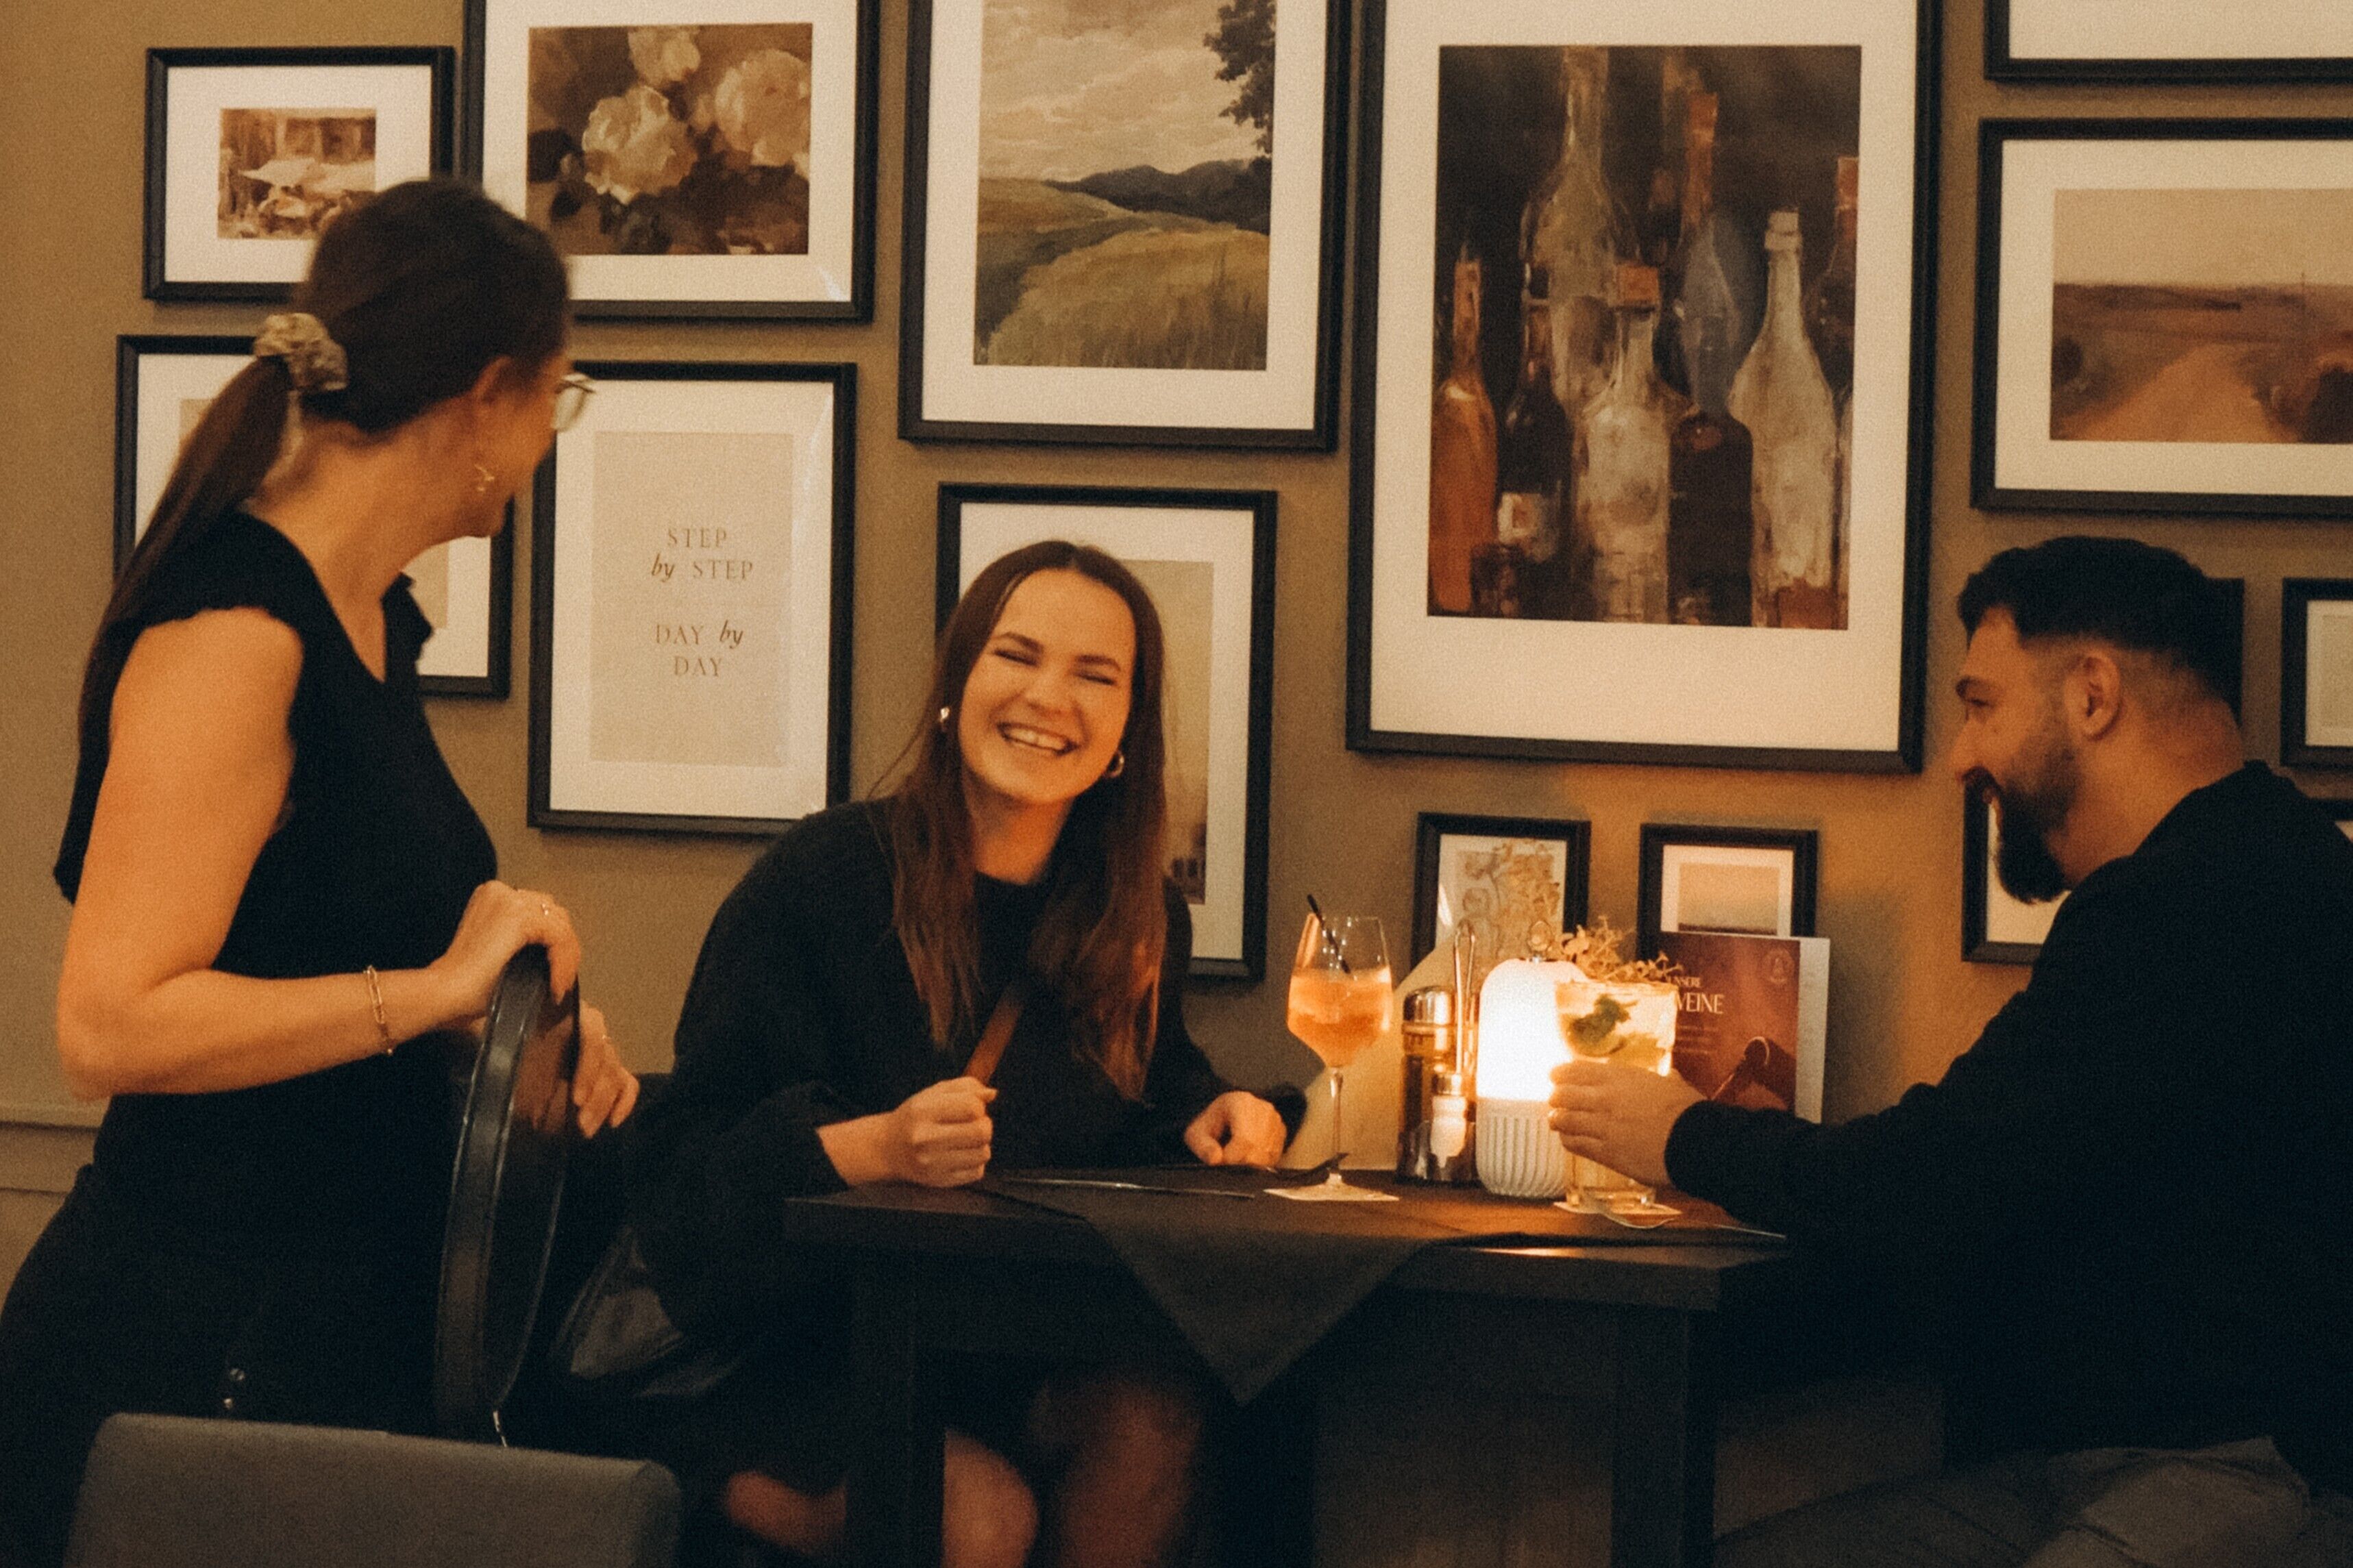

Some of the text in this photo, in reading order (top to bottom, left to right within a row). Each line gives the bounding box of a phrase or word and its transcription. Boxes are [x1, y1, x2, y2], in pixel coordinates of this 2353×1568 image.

[667, 527, 727, 548] STEP
[651, 552, 753, 583] by STEP
[656, 619, 743, 649] DAY by
[674, 656, 722, 677] DAY
